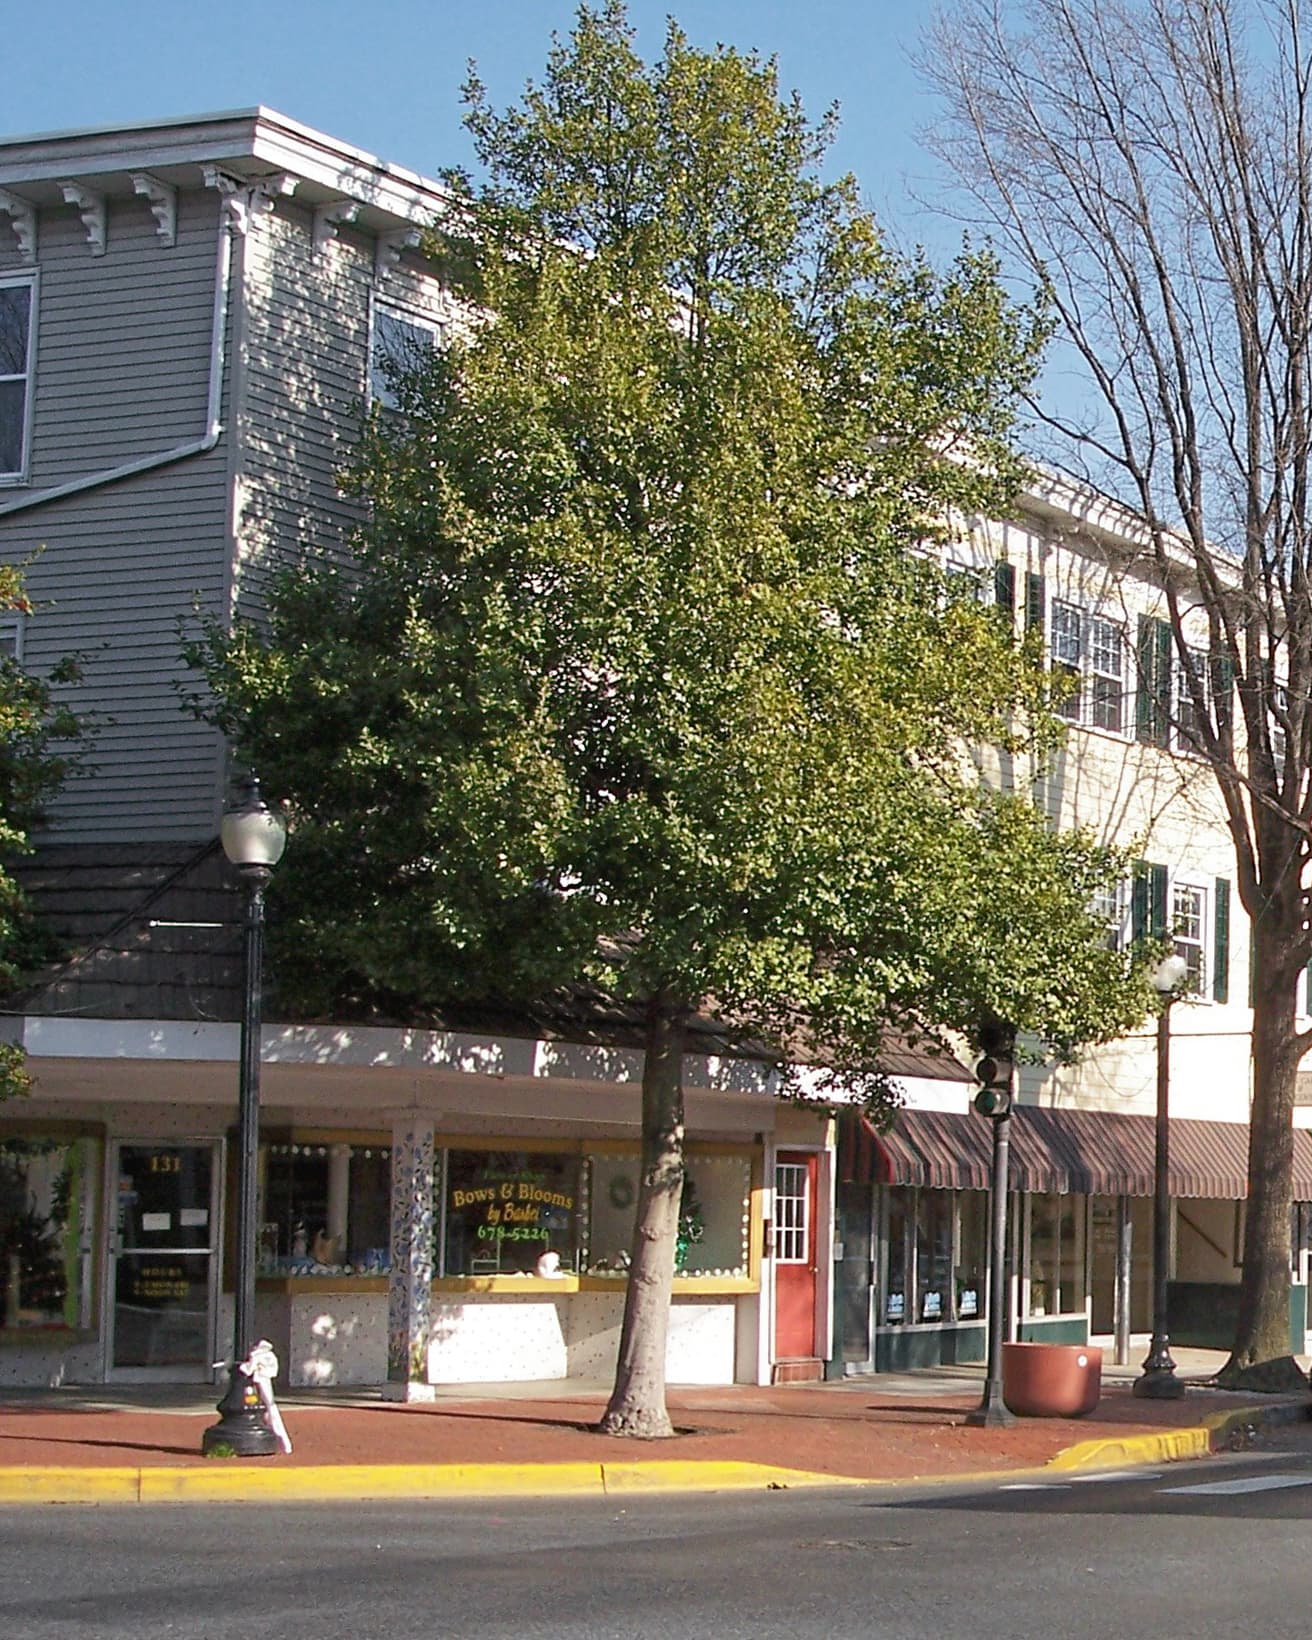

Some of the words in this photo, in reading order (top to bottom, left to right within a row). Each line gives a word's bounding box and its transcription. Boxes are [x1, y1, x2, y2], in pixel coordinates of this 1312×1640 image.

[151, 1155, 181, 1173] 131
[453, 1187, 496, 1208] Bows
[501, 1182, 515, 1199] &
[519, 1183, 574, 1210] Blooms
[477, 1224, 549, 1241] 678-5226
